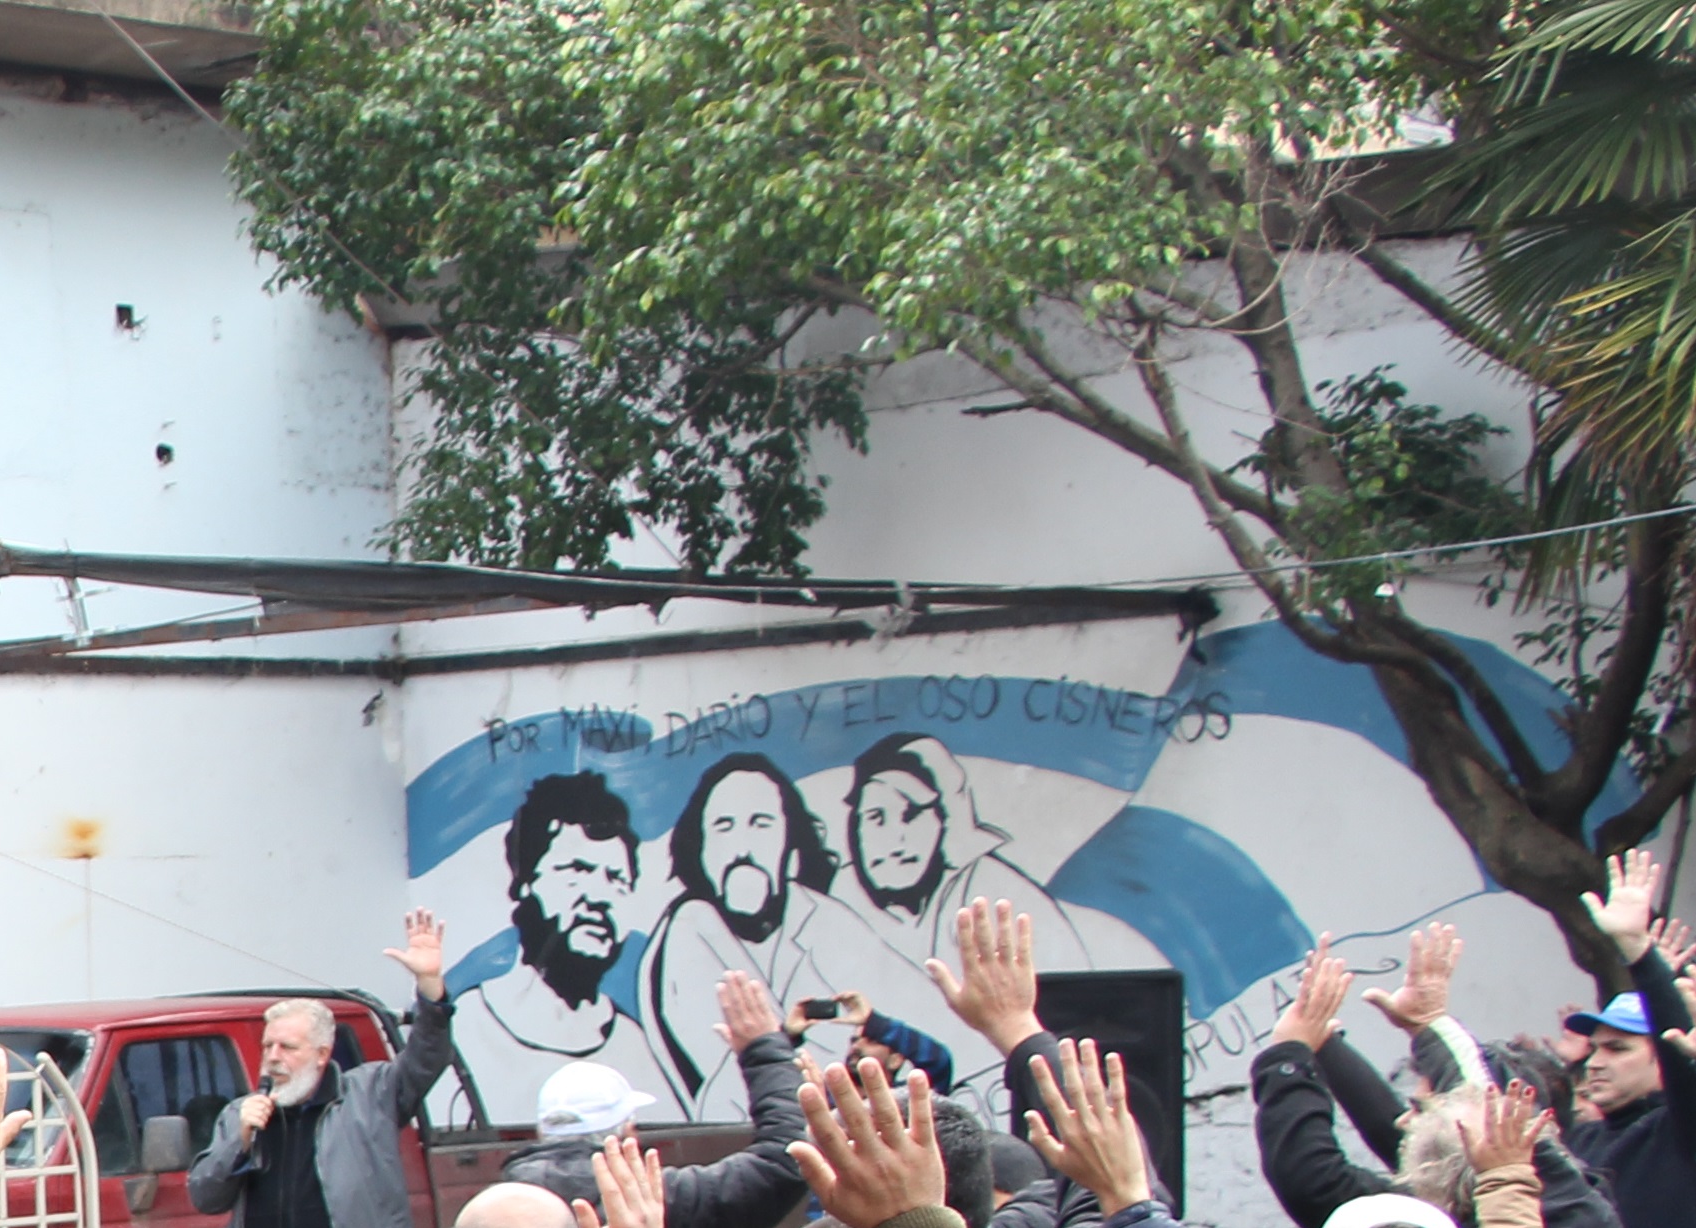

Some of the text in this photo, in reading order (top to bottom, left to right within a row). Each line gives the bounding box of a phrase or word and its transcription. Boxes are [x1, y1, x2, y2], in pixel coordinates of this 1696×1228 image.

[484, 717, 542, 764] POR
[794, 692, 821, 742] Y
[842, 680, 897, 727] EL
[916, 673, 1002, 722] OSO
[1183, 966, 1305, 1084] PULA
